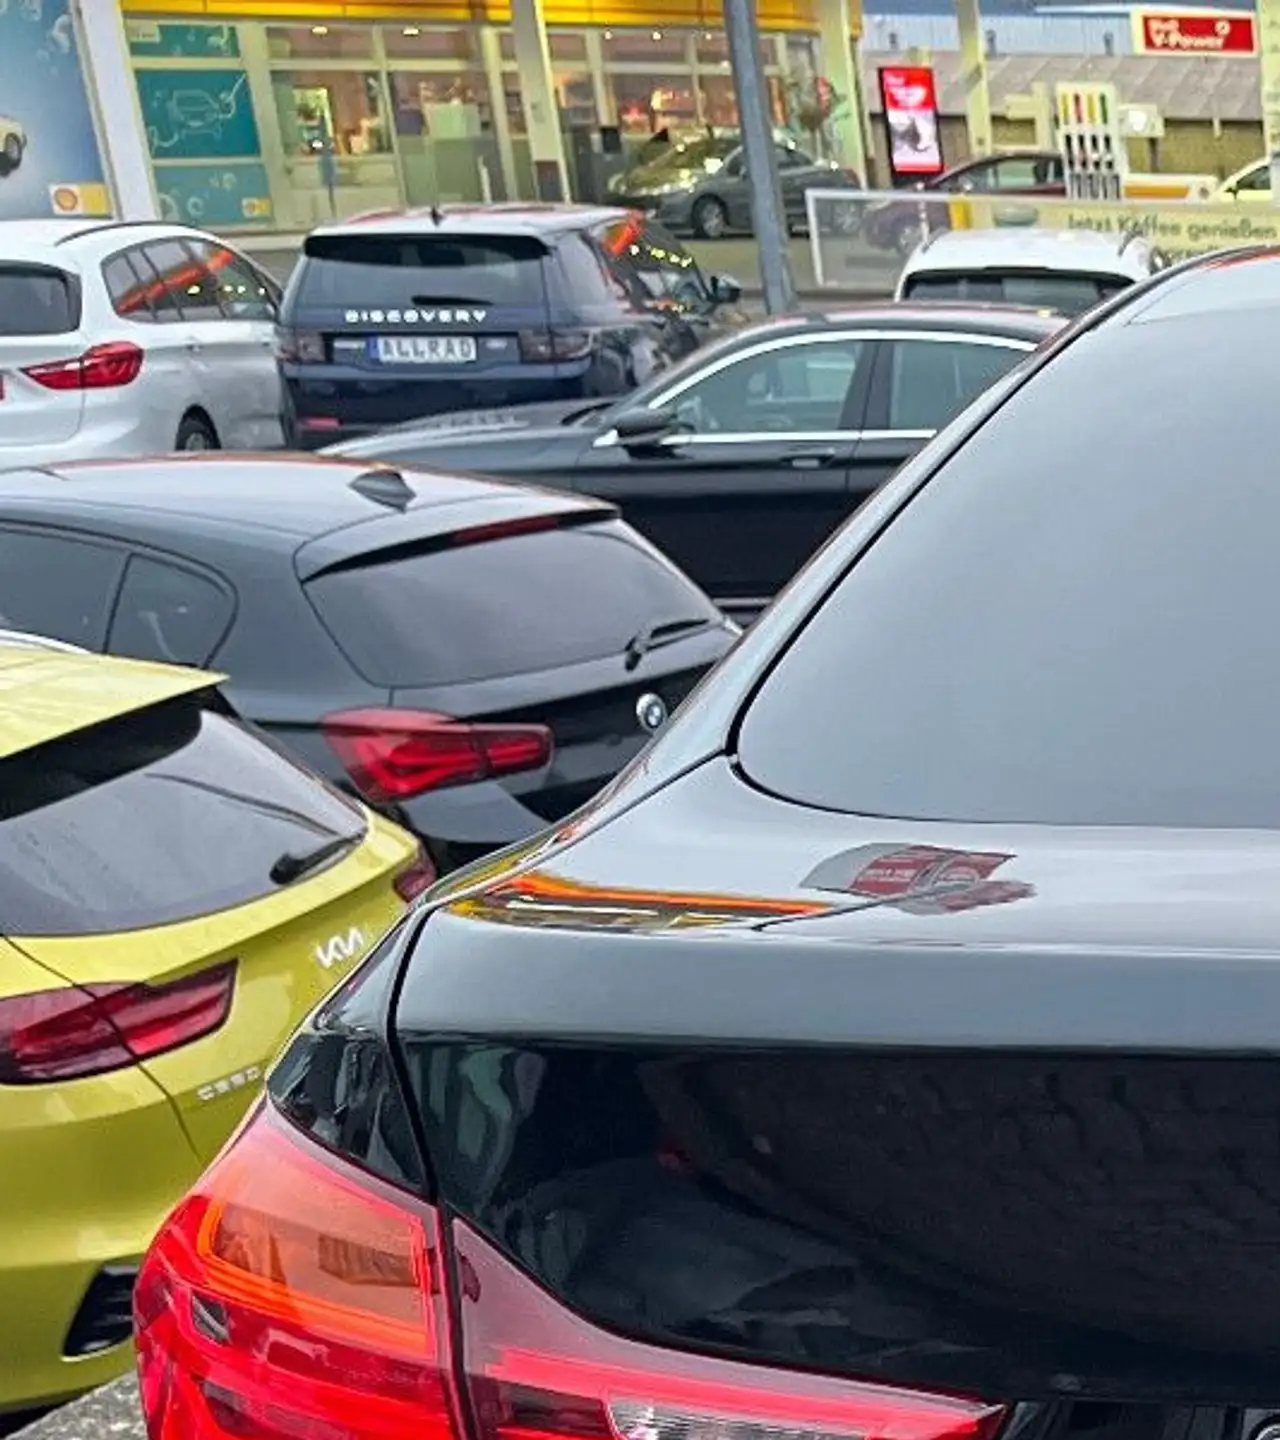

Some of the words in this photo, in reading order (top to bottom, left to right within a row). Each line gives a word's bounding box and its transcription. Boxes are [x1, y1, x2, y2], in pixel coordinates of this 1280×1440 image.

[1187, 218, 1278, 241] genießen
[344, 308, 487, 324] DISCOVERY
[383, 339, 473, 358] ALLRAD
